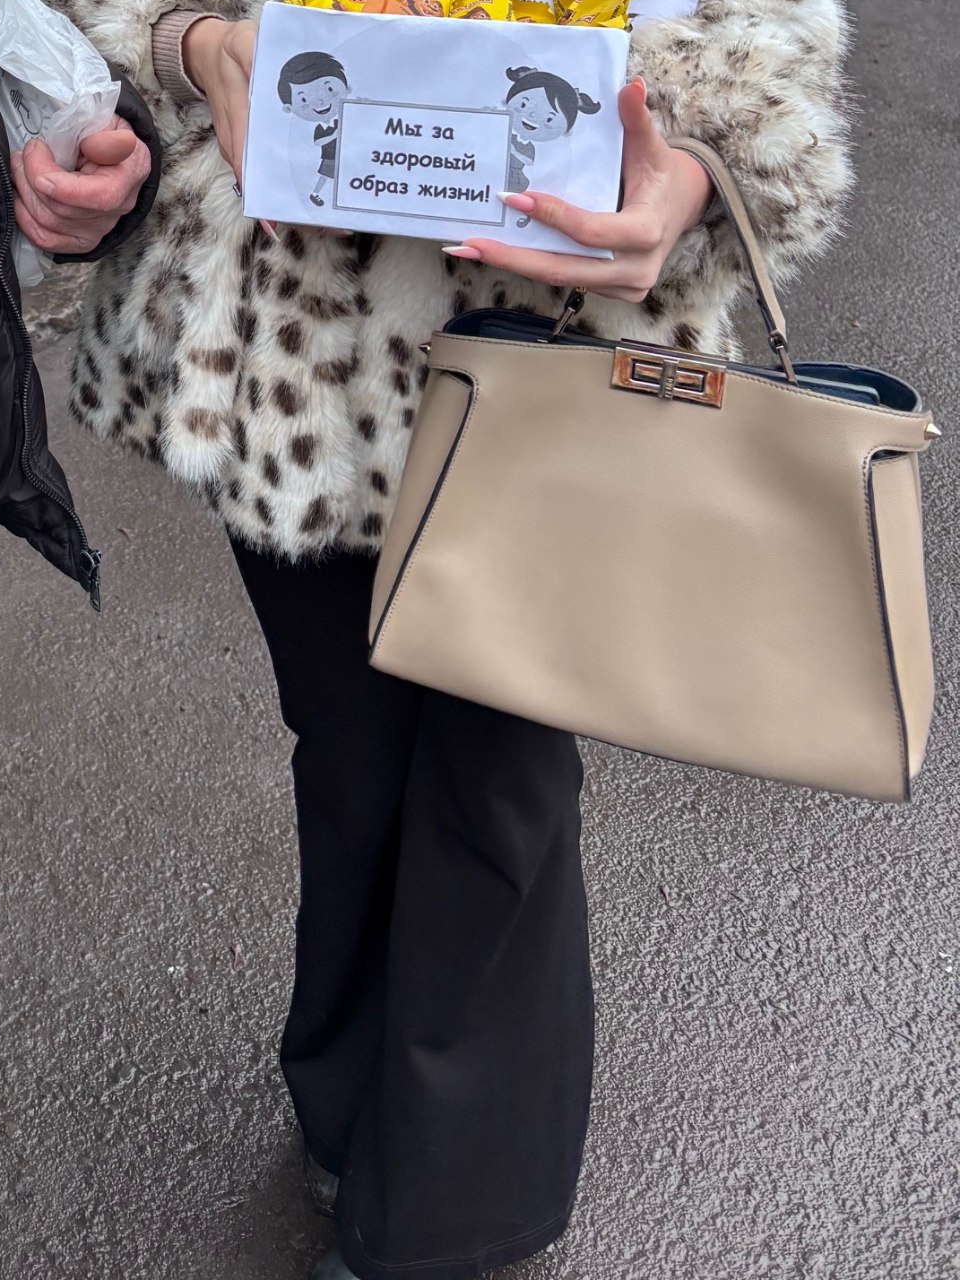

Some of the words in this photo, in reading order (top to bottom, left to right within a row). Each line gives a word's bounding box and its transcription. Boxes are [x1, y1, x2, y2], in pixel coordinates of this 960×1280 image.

[384, 117, 423, 138] Мы
[431, 126, 455, 141] за
[371, 150, 476, 173] здоровый
[349, 174, 409, 197] образ
[417, 184, 490, 204] жизни!
